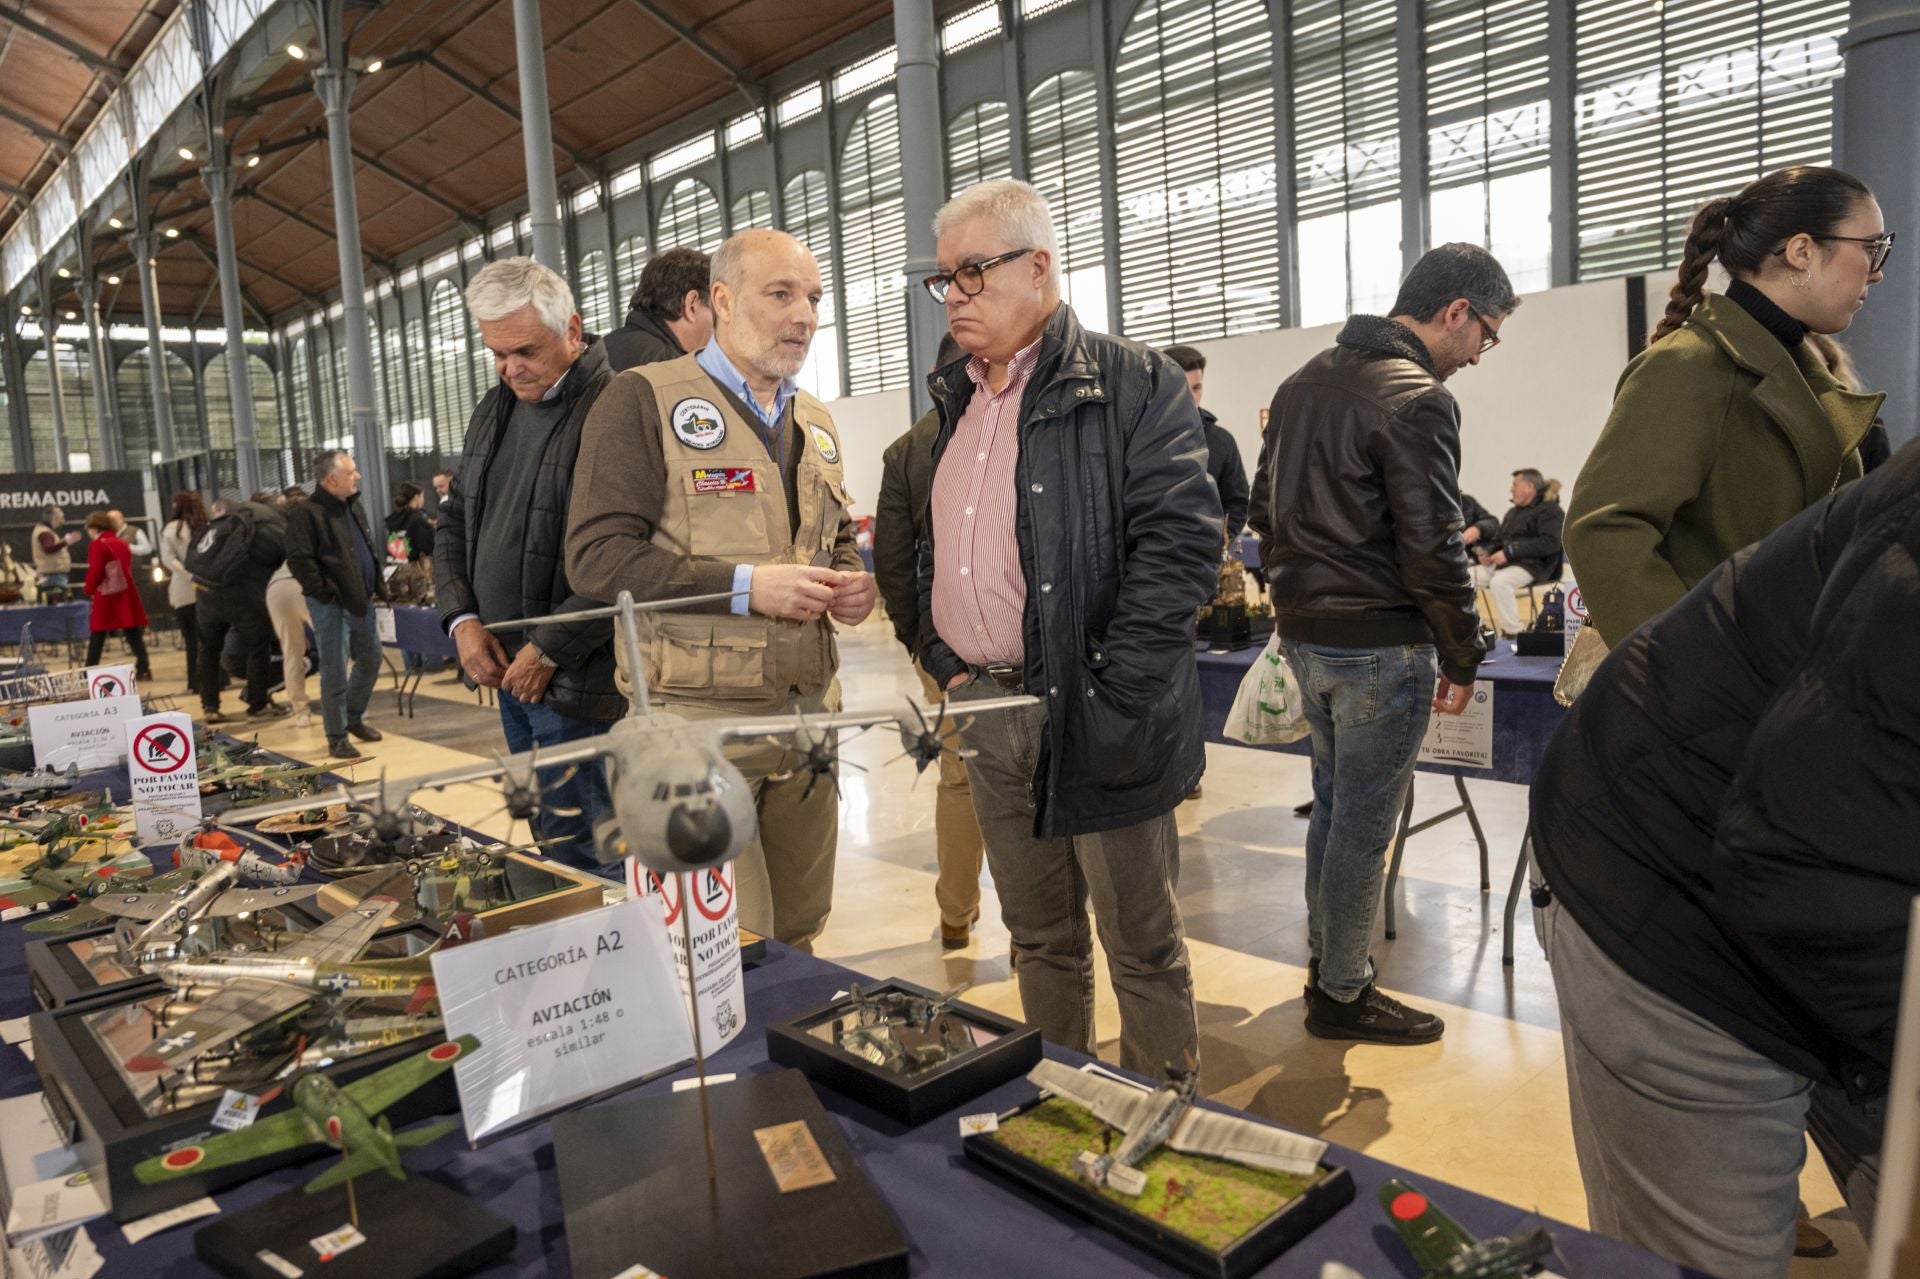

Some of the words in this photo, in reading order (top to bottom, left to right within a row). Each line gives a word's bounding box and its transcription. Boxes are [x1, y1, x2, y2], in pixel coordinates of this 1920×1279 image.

[104, 706, 119, 716] A3
[134, 776, 157, 784] POR
[160, 773, 196, 782] FAVOR
[138, 785, 154, 793] NO
[156, 783, 194, 793] TOCAR
[446, 923, 463, 939] A
[692, 927, 716, 949] POR
[495, 946, 588, 985] CATEGORÍA
[596, 930, 624, 956] A2
[697, 946, 714, 963] NO
[532, 988, 612, 1026] AVIACIÓN
[527, 1025, 574, 1048] escala
[580, 1011, 610, 1032] 1:48
[616, 1009, 625, 1019] o
[554, 1032, 607, 1058] similar
